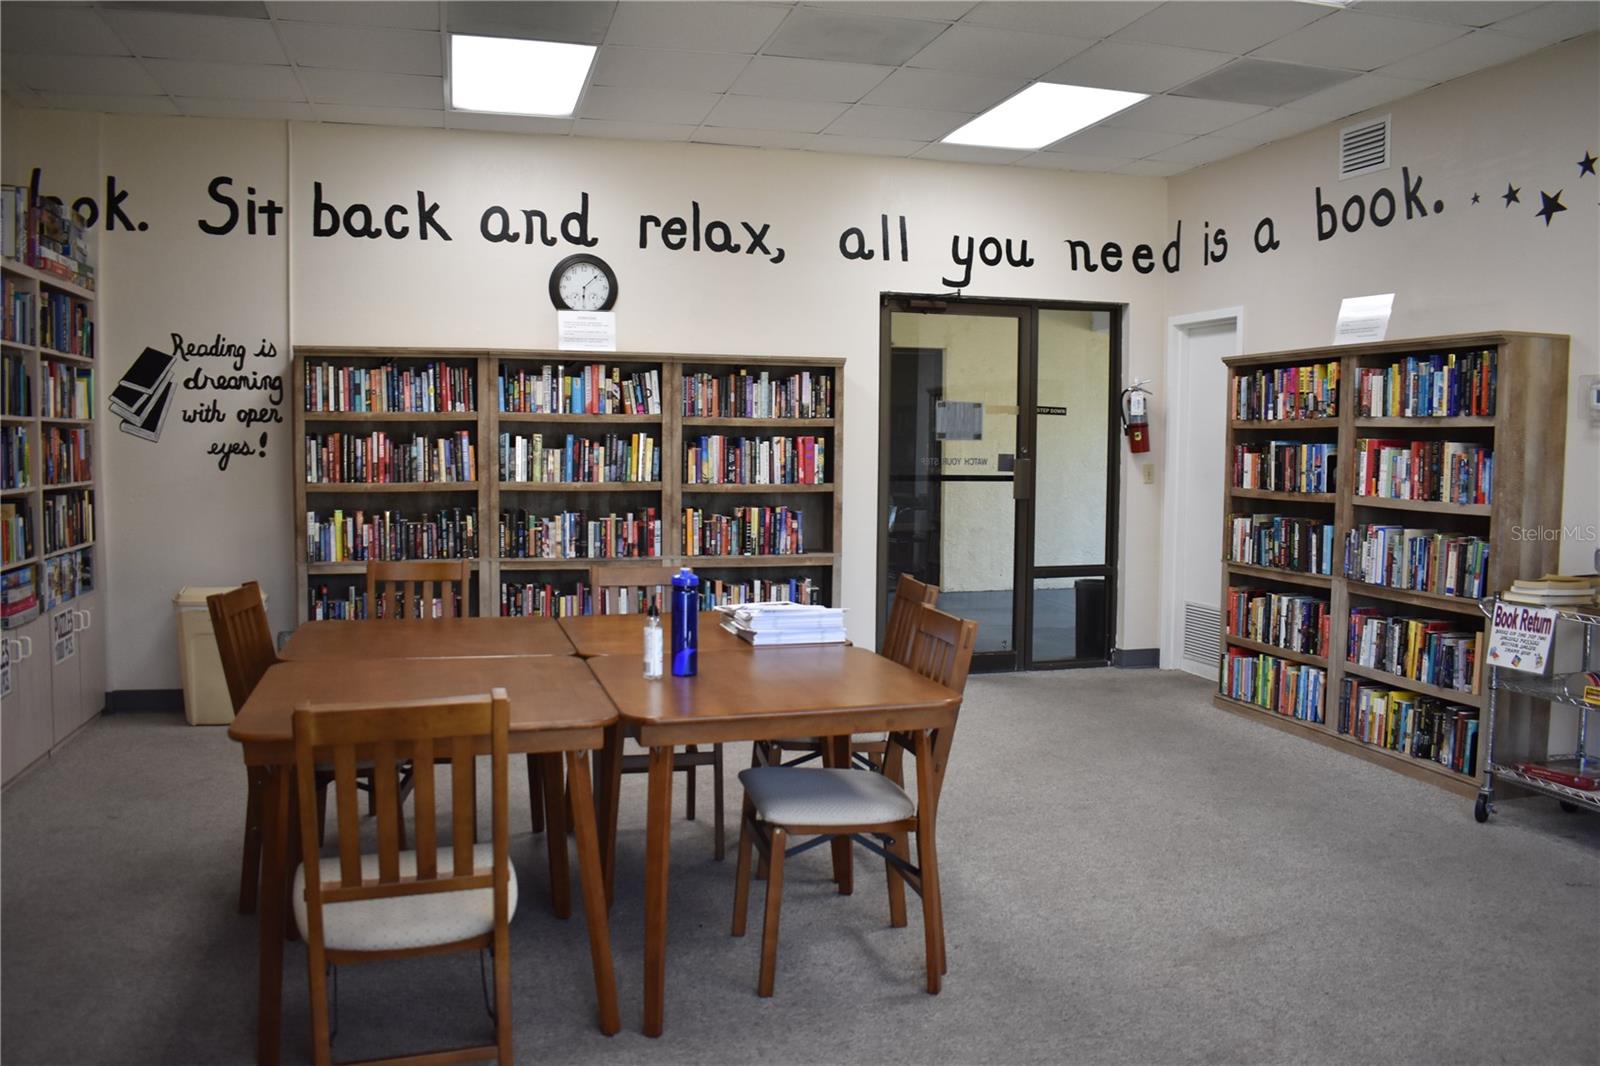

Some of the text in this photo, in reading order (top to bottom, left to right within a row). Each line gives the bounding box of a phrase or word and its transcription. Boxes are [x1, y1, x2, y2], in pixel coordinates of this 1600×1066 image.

[198, 176, 283, 235] Sit
[314, 182, 452, 240] back
[481, 193, 598, 247] and
[640, 201, 784, 263] relax,
[840, 215, 907, 261] all
[943, 236, 1033, 287] you
[1065, 220, 1182, 274] need
[1205, 222, 1227, 265] is
[1255, 218, 1279, 253] a
[1315, 166, 1444, 241] book.
[171, 333, 277, 371] Reading is
[181, 399, 283, 427] with open
[207, 431, 268, 471] eyes!
[1494, 605, 1520, 630] Book
[1519, 608, 1552, 635] Return
